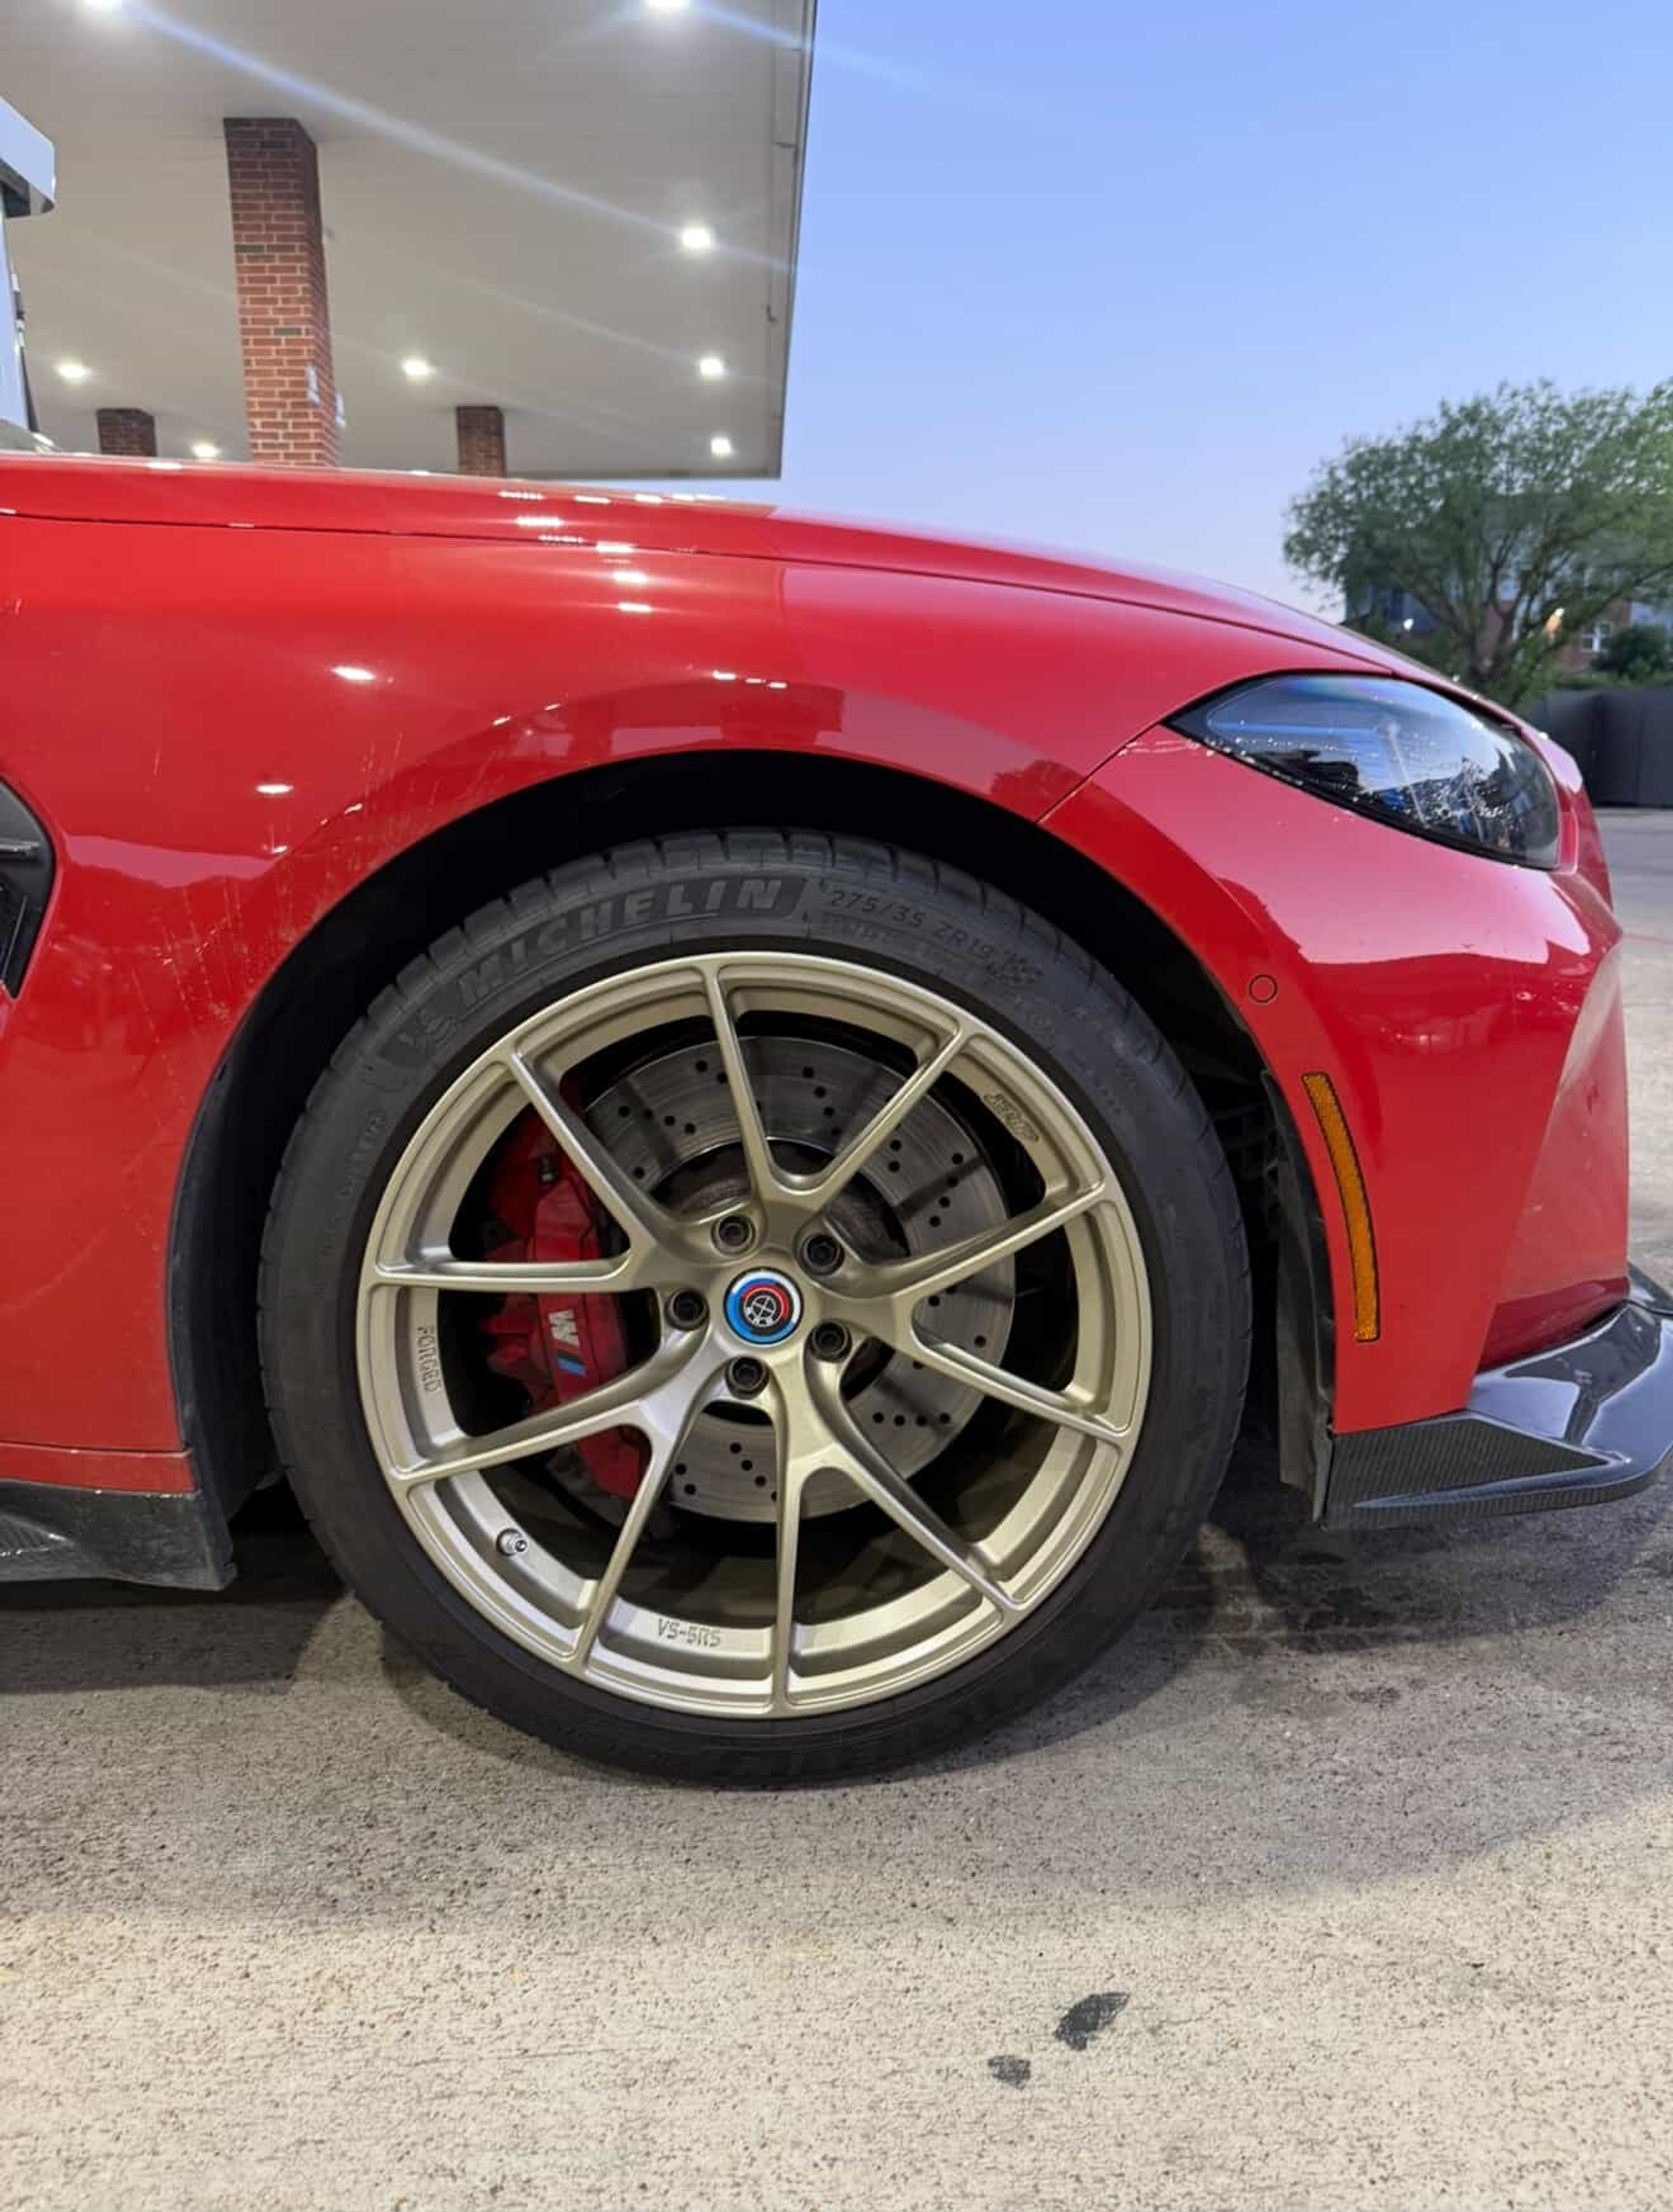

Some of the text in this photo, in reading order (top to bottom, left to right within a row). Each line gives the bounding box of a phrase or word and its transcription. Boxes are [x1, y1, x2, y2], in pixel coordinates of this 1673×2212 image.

[458, 879, 782, 1006] MICHELIN
[831, 891, 925, 927] 275/35
[934, 921, 995, 958] ZR19
[417, 1326, 441, 1391] FORGED
[659, 1618, 721, 1647] VS-5RS
